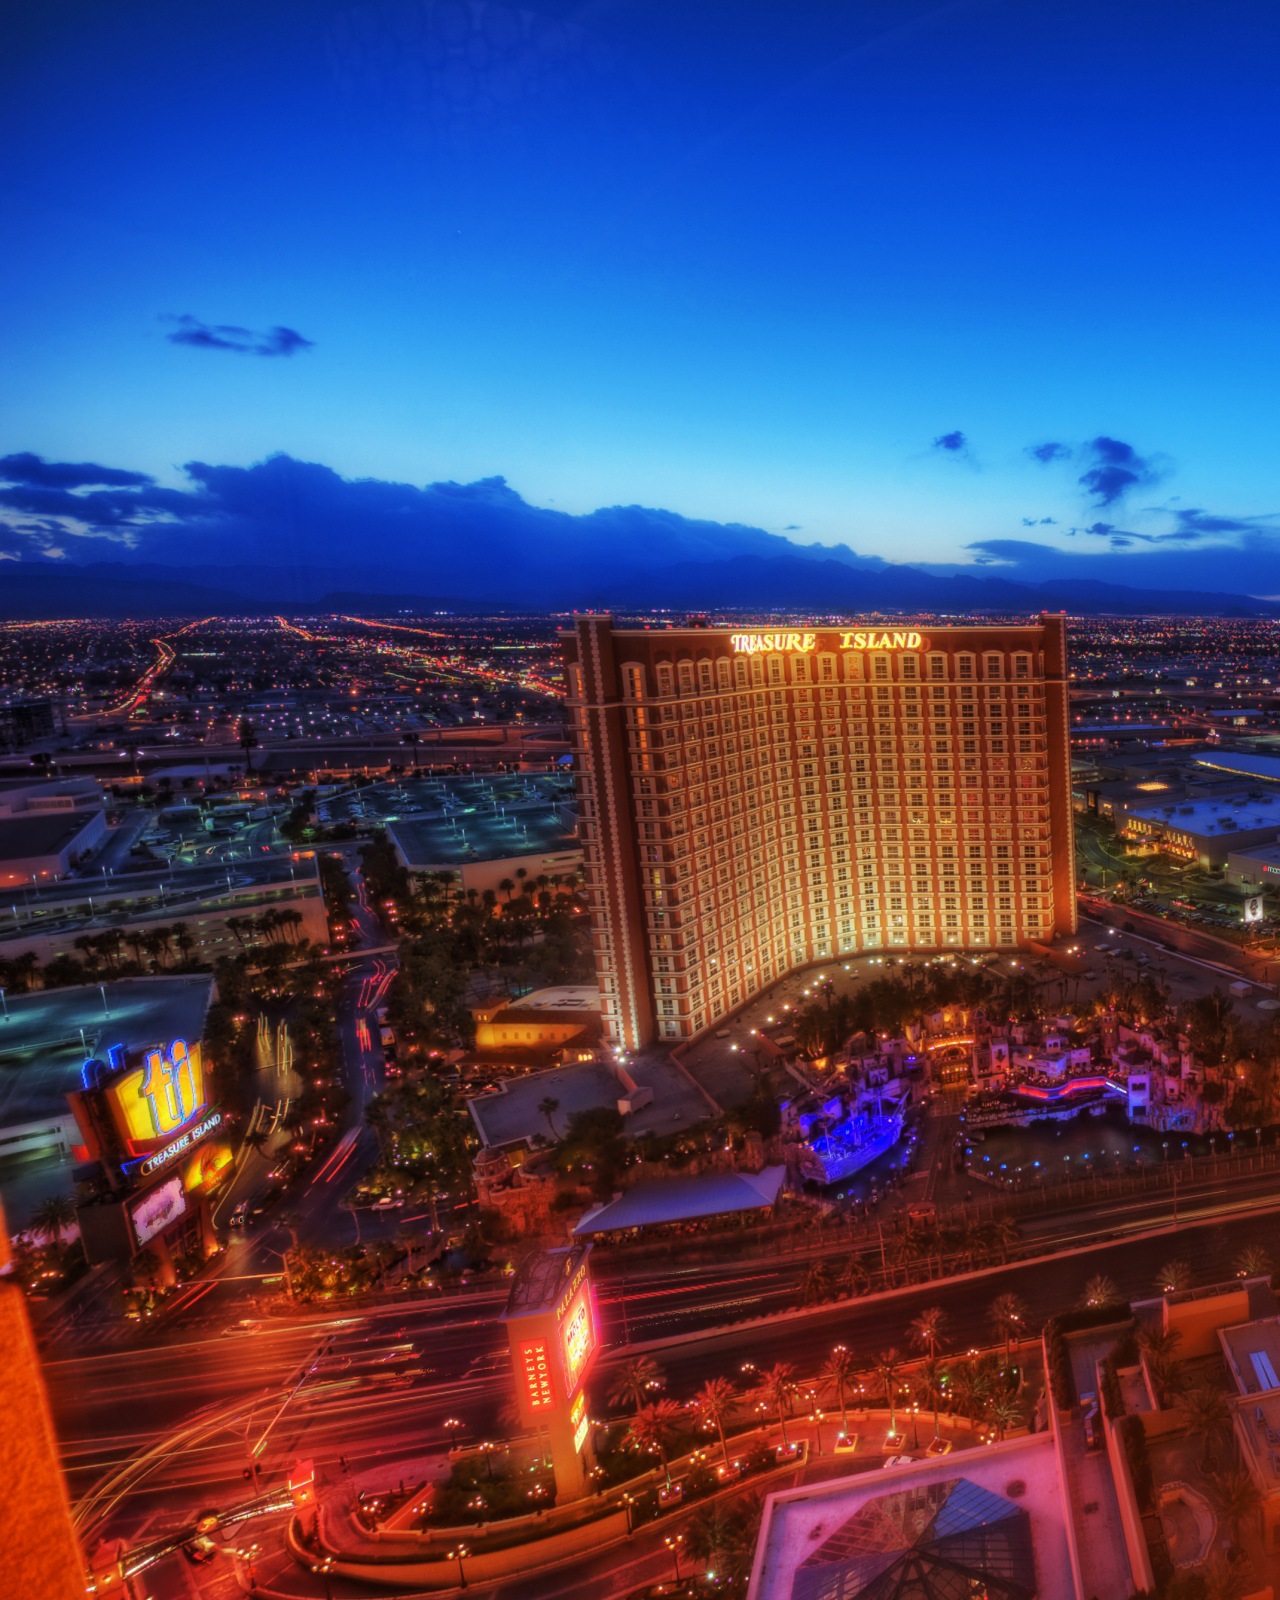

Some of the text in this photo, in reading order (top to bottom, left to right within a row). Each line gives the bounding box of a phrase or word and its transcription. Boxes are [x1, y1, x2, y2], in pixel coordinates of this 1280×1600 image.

[731, 632, 922, 655] TREASURE ISLAND
[143, 1038, 197, 1136] ti
[147, 1113, 221, 1171] TREASURE ISLAND
[556, 1264, 586, 1321] PALAZZO
[524, 1348, 541, 1406] BARNEYS
